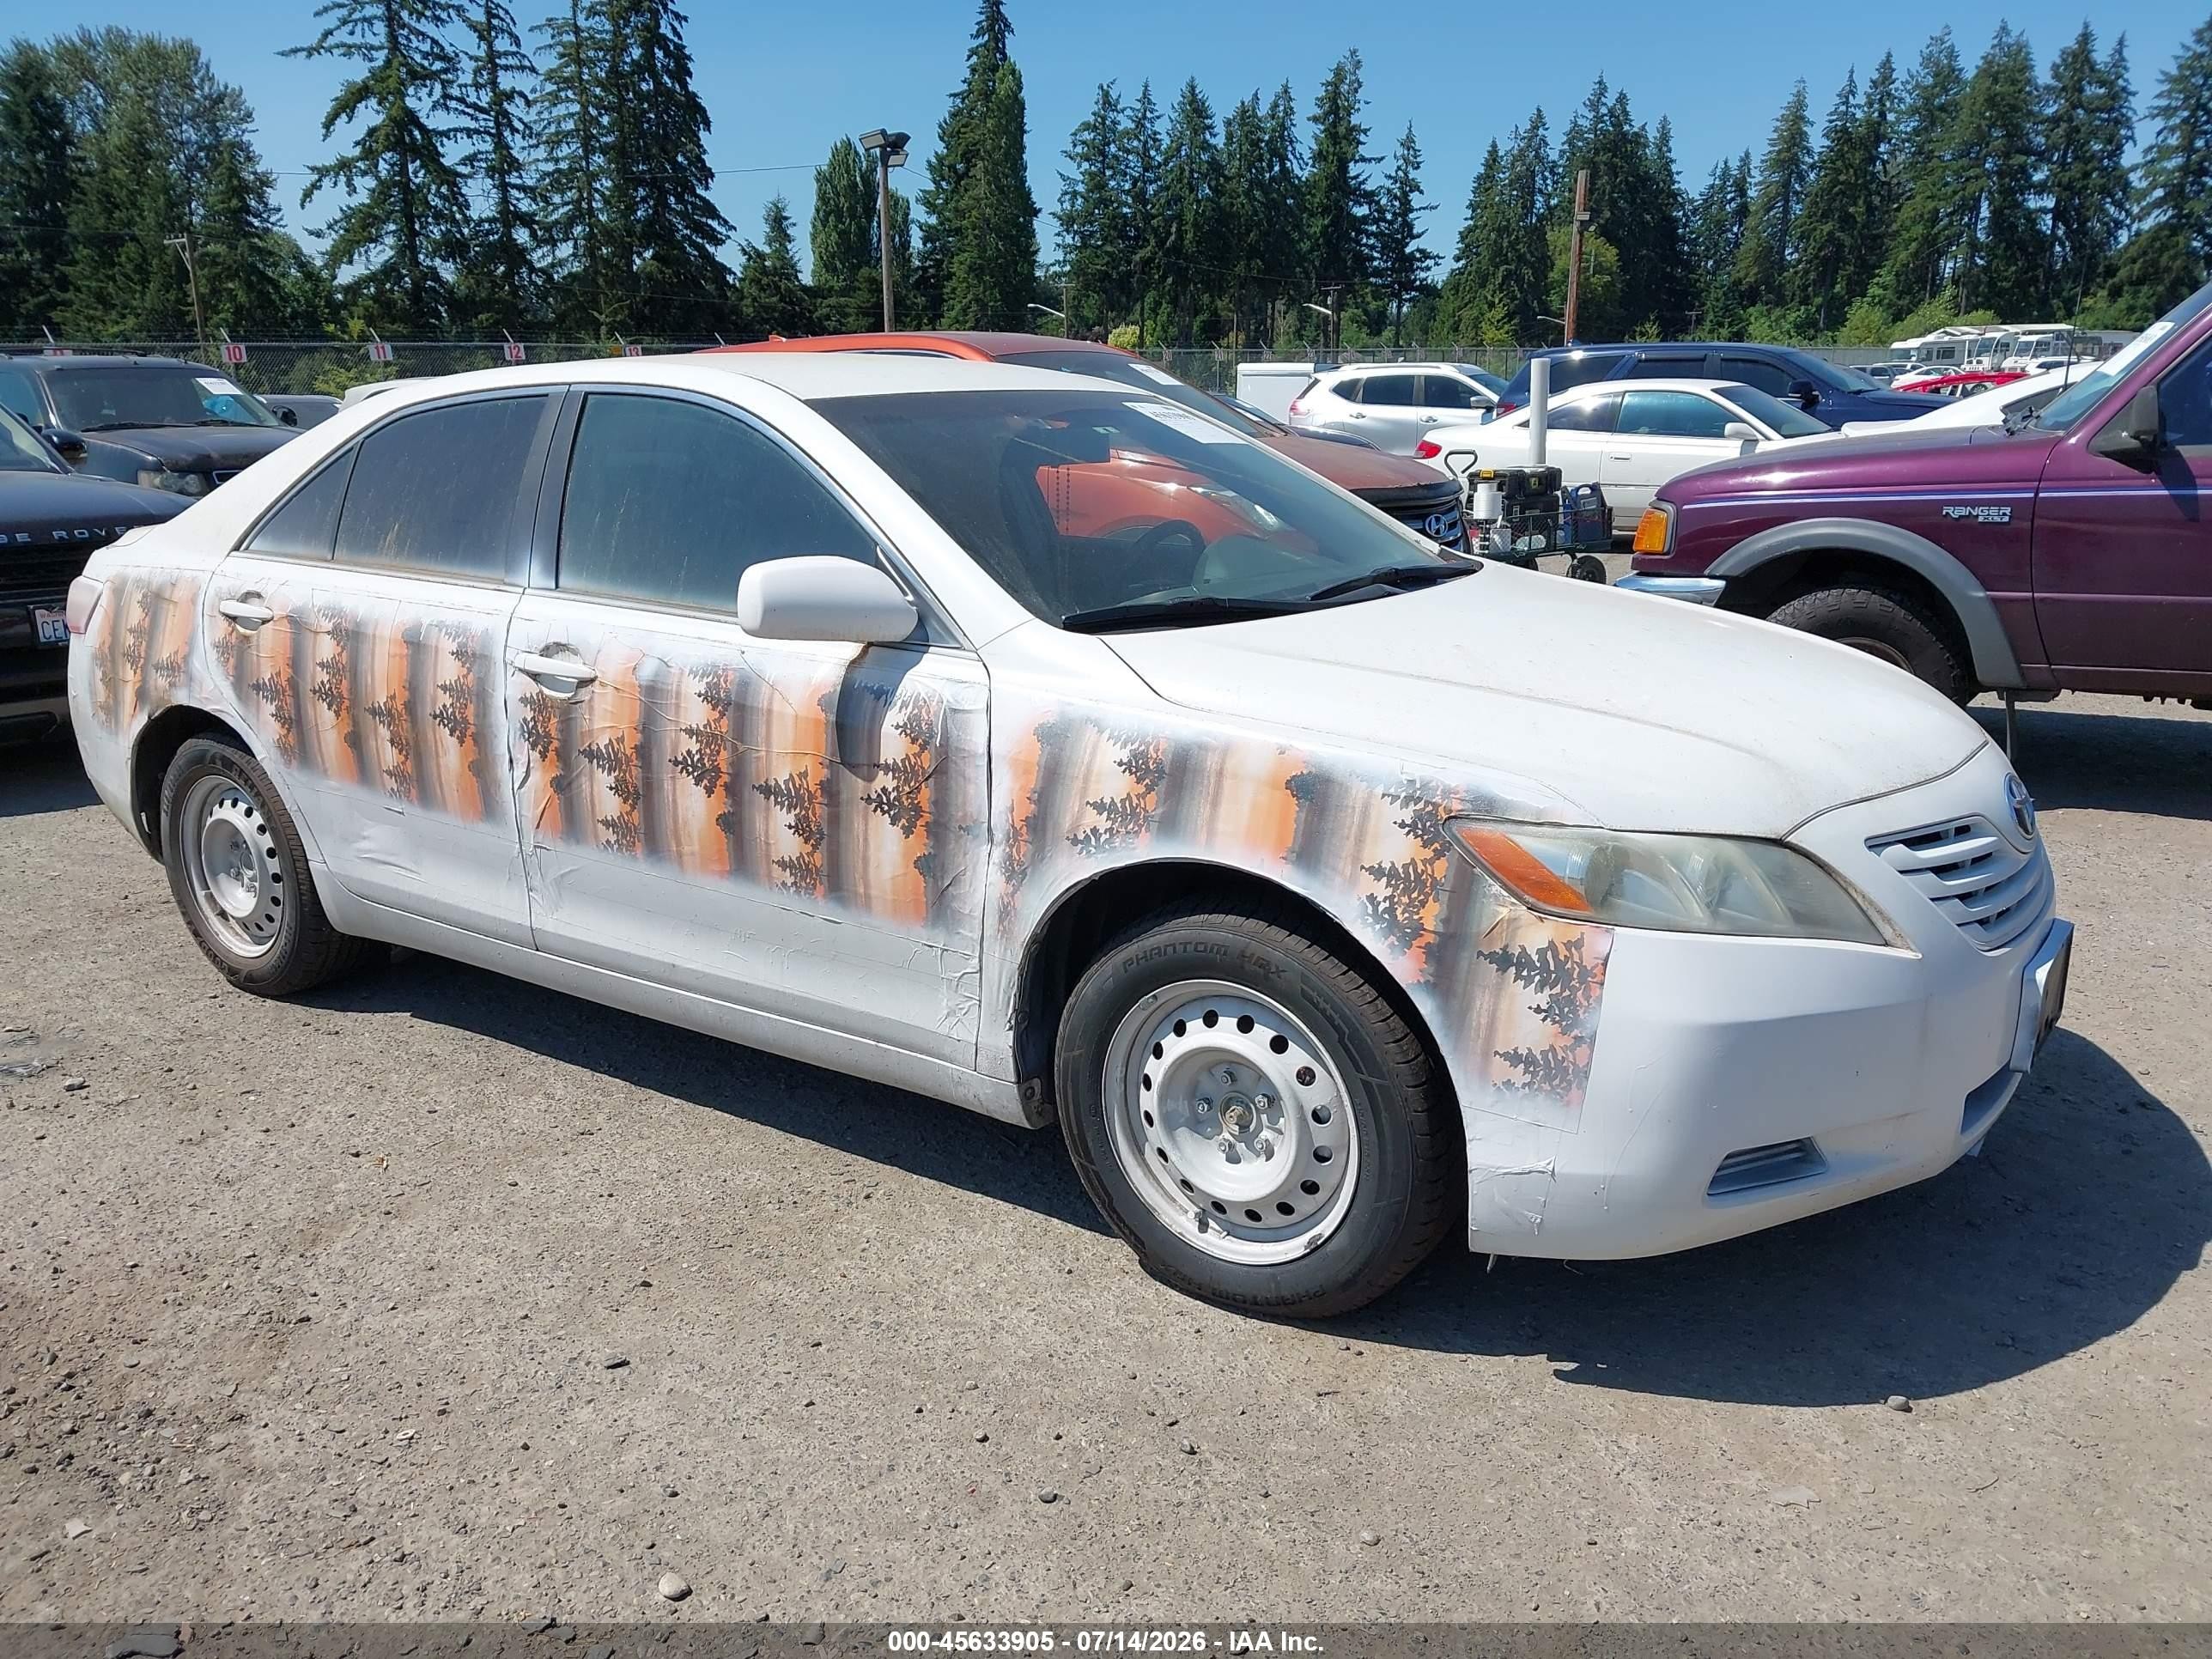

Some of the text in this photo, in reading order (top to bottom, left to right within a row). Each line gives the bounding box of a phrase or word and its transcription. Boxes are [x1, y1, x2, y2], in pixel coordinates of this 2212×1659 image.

[226, 345, 243, 362] 10
[374, 344, 387, 359] 11
[507, 344, 522, 359] 12
[629, 346, 640, 356] 13
[1942, 506, 2011, 518] RANGER
[52, 526, 144, 540] ROVE
[1122, 941, 1231, 974] PHANTOM
